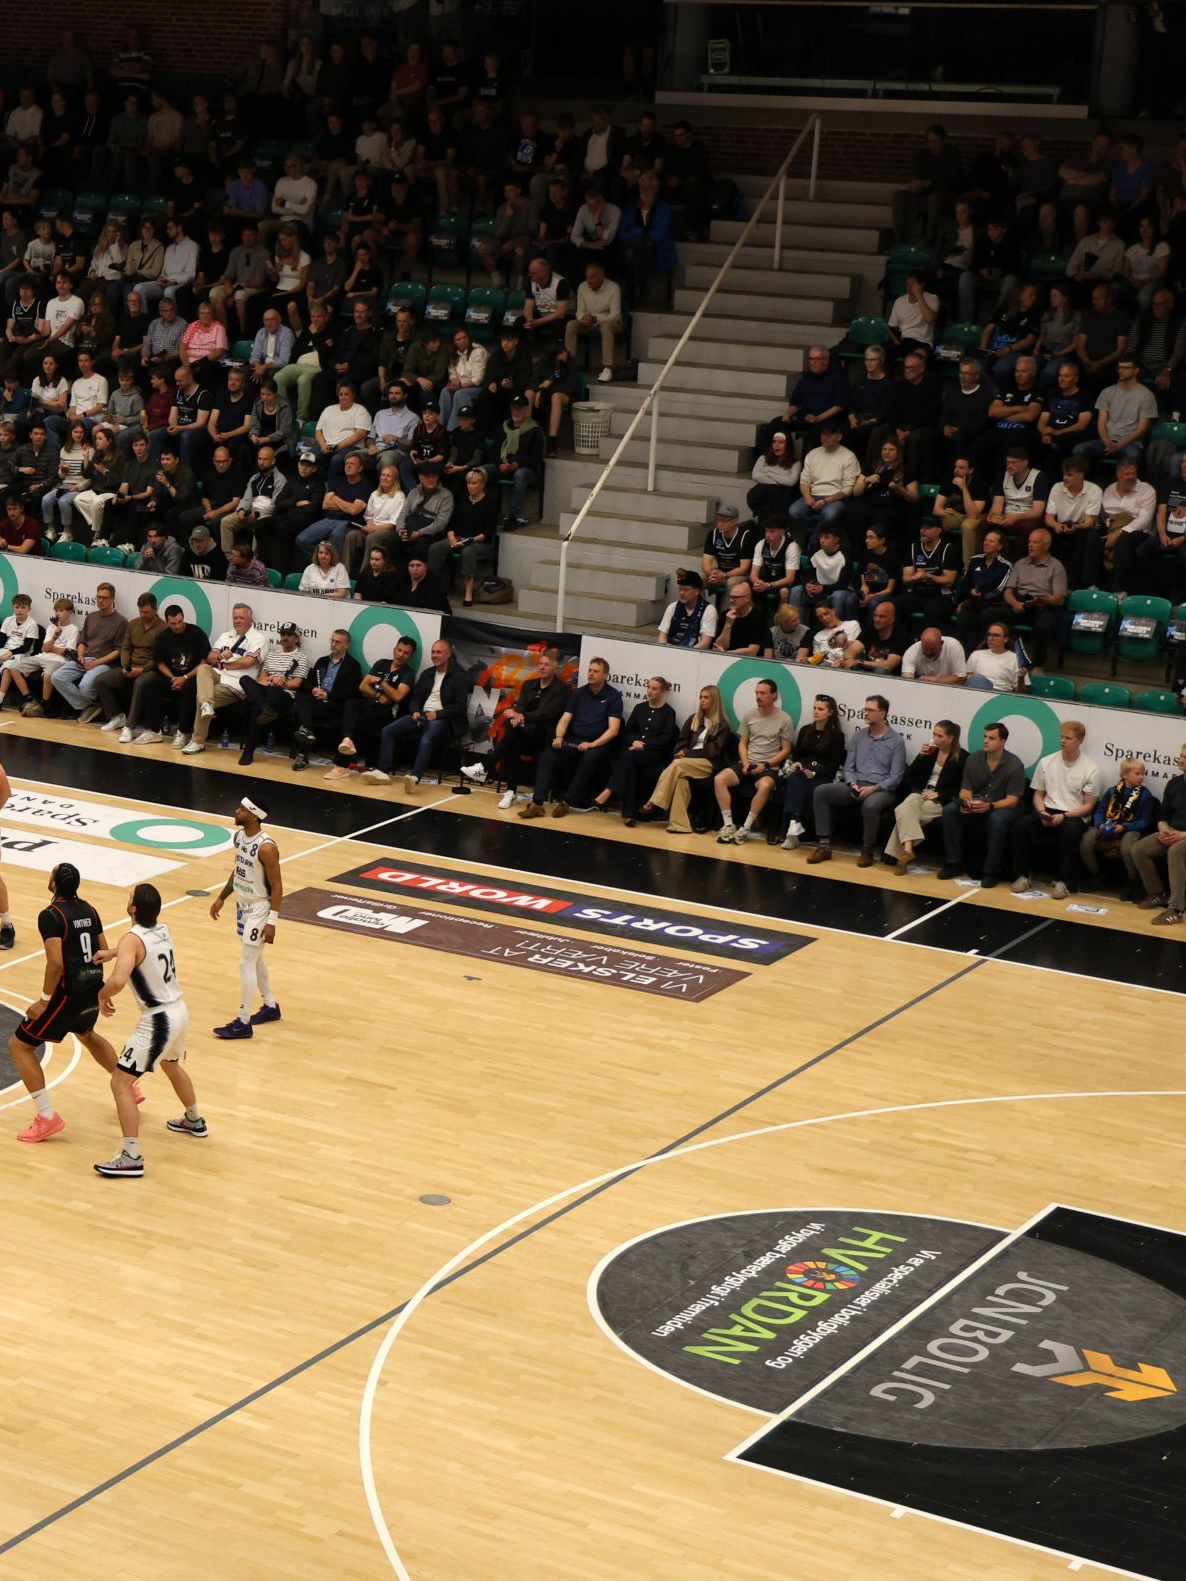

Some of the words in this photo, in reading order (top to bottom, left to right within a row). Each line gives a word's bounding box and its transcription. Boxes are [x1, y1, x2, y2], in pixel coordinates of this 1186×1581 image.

[45, 587, 97, 606] Sparekas
[252, 619, 317, 639] aresen
[607, 673, 682, 692] arekaen
[838, 703, 932, 730] Spaassen
[1104, 743, 1180, 766] Sparekas
[250, 843, 259, 857] 8
[377, 870, 553, 911] WORLD
[72, 917, 92, 929] VINTHER
[249, 927, 259, 942] 8
[573, 907, 770, 950] SPORTS
[79, 932, 93, 964] 9
[480, 946, 527, 958] AT
[516, 939, 609, 964] VÆRT!
[157, 948, 177, 984] 24
[527, 954, 659, 986] ELSKER
[613, 959, 704, 985] VÆRE
[661, 980, 688, 993] VI
[809, 1222, 826, 1232] vi
[774, 1227, 821, 1254] bygger
[906, 1255, 925, 1267] er
[916, 1249, 942, 1260] Vi
[711, 1251, 787, 1296] bæredygtigt
[853, 1264, 914, 1309] specialister
[682, 1226, 908, 1365] HVORDAN
[983, 1270, 1070, 1329] JCN
[651, 1298, 720, 1337] fremtiden
[784, 1307, 863, 1359] boligbyggeri
[765, 1355, 793, 1370] og
[869, 1318, 1015, 1409] BOLIG
